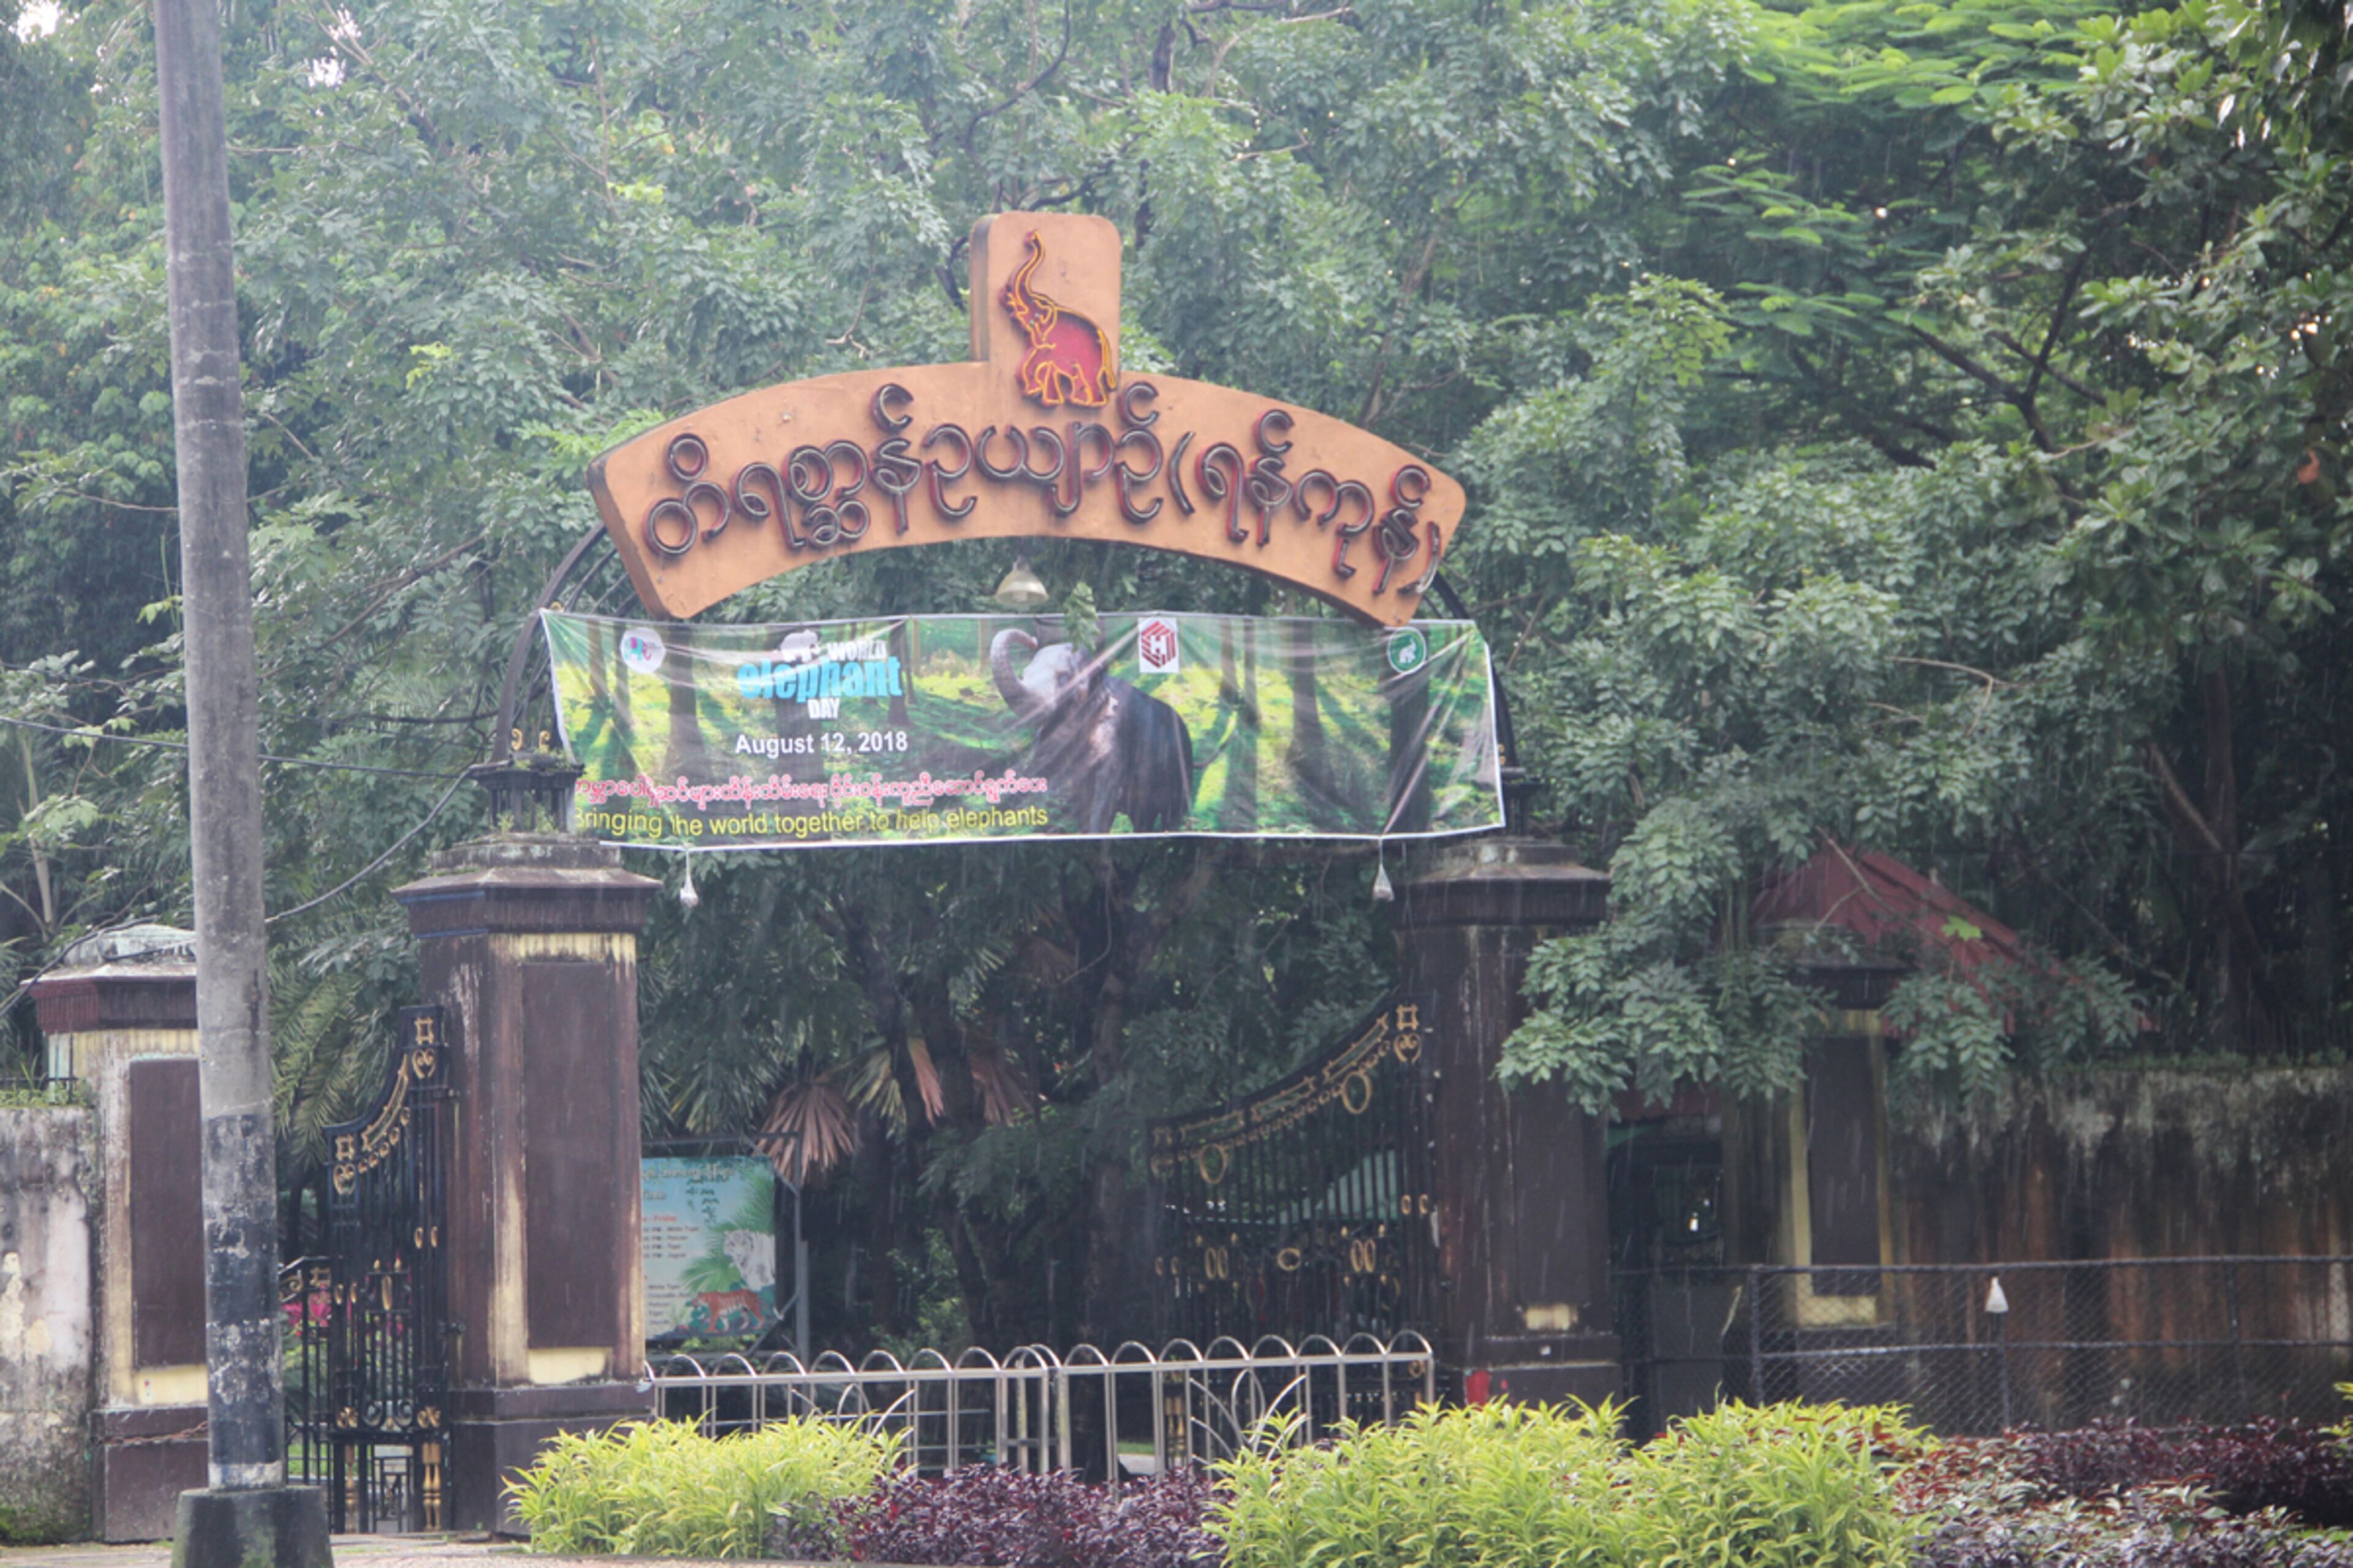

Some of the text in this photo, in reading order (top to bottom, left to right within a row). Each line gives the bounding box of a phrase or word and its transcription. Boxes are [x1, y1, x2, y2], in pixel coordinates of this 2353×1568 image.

[827, 639, 888, 661] WORLD
[737, 656, 903, 703] elephant
[807, 697, 841, 719] DAY
[735, 730, 909, 759] August 12, 2018
[708, 812, 768, 835] world
[773, 810, 864, 838] together
[870, 811, 890, 831] to
[896, 807, 941, 833] help
[945, 804, 1049, 828] elephants
